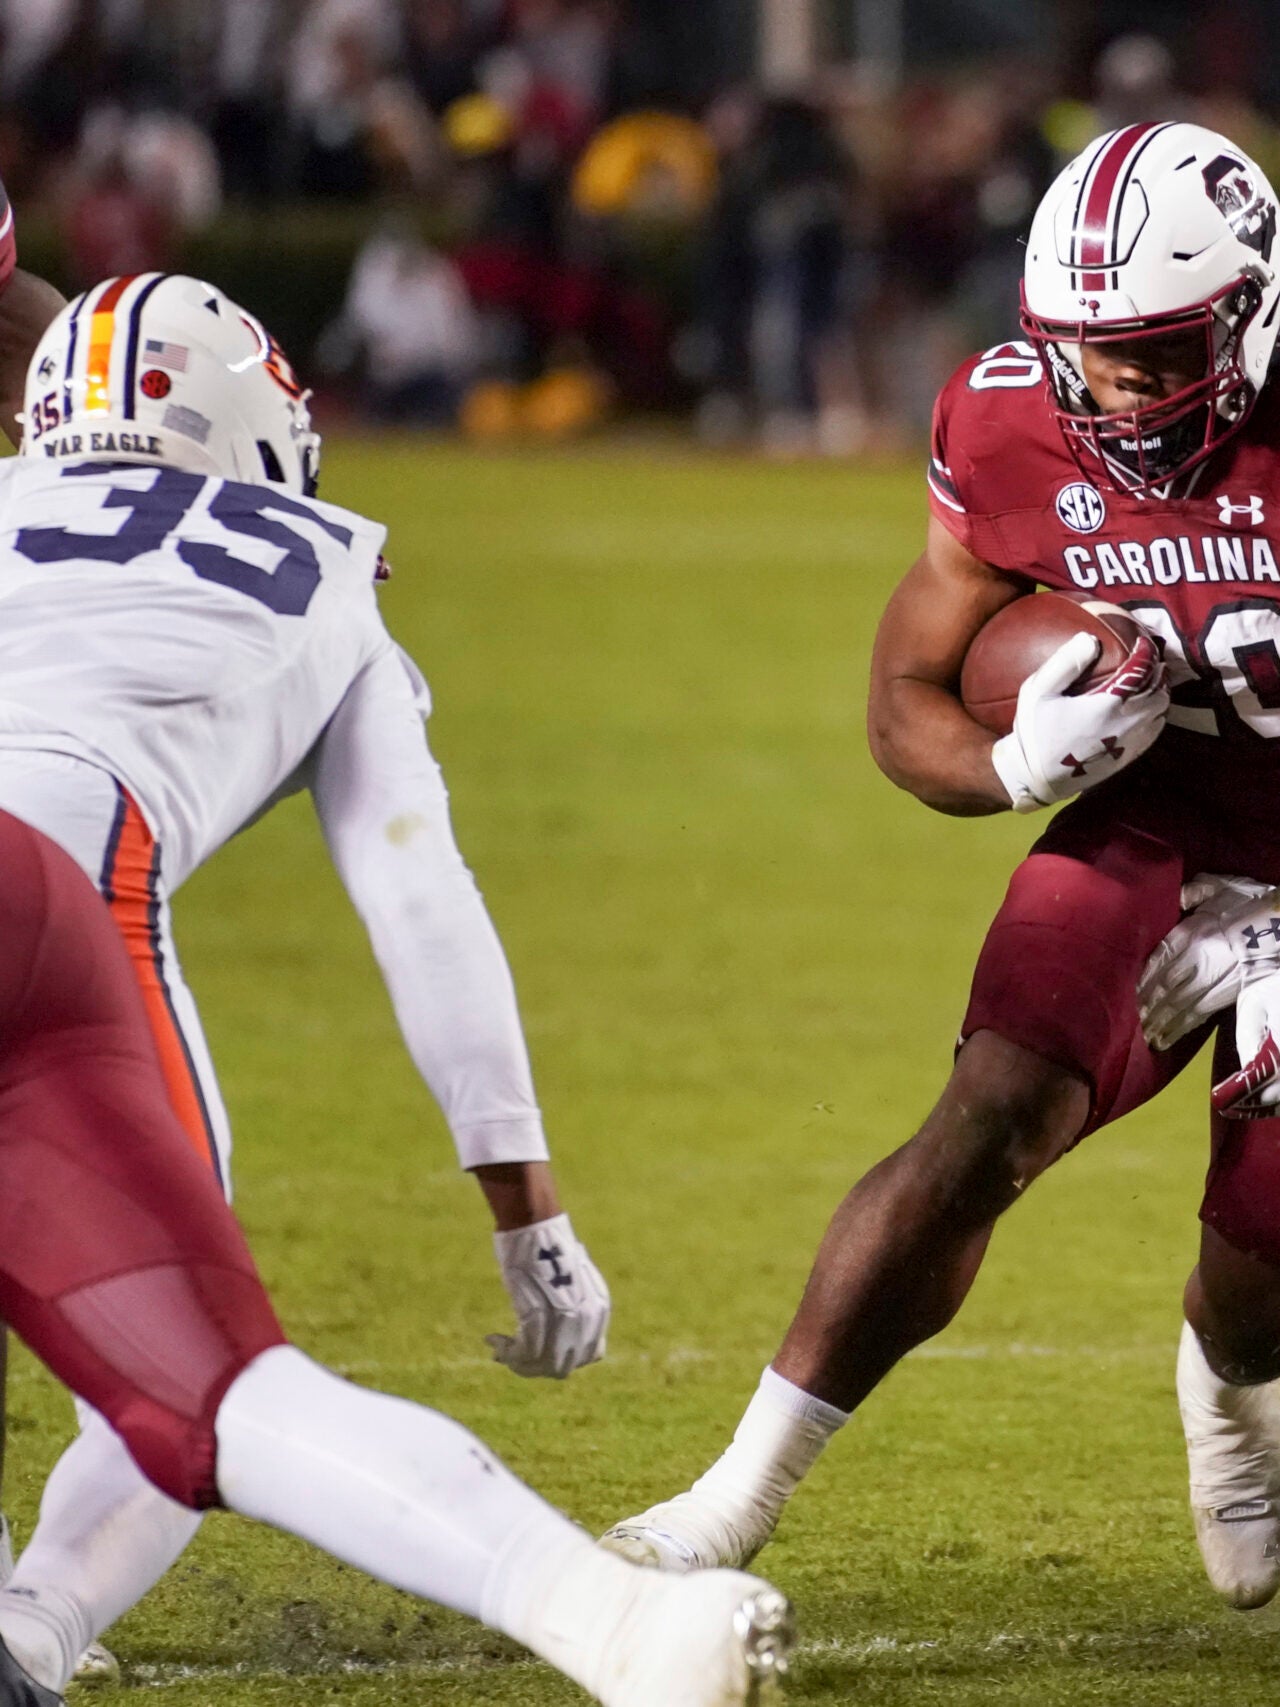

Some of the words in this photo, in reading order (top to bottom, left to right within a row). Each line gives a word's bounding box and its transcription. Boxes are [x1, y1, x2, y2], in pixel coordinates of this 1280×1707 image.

[968, 340, 1044, 391] 20
[31, 391, 60, 440] 35
[44, 435, 83, 458] WAR
[90, 433, 161, 455] EAGLE
[1060, 484, 1103, 531] SEC
[13, 461, 355, 616] 35
